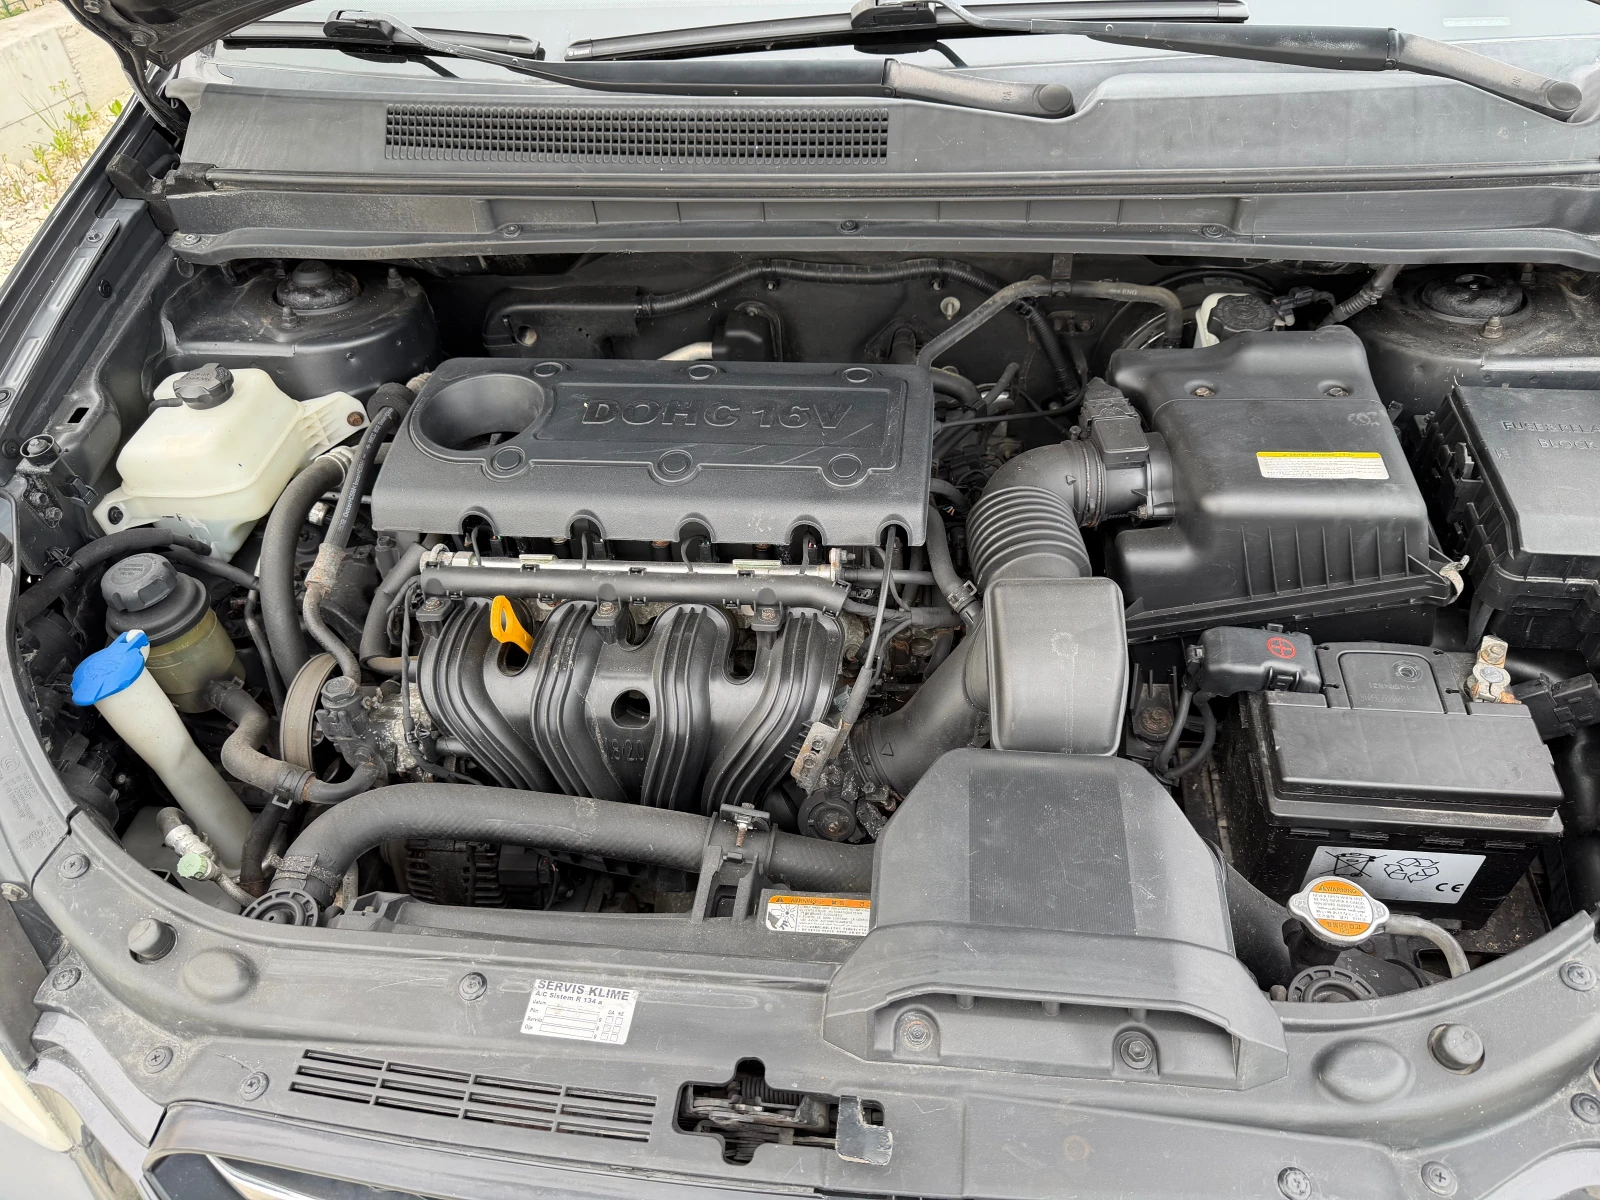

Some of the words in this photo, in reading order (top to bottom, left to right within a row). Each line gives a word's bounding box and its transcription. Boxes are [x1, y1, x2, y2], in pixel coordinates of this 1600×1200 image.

[581, 400, 741, 427] DOHC
[752, 402, 853, 429] 16V
[1537, 439, 1598, 450] BLOCK
[1435, 882, 1465, 893] CE
[537, 980, 585, 995] SERVIS
[588, 986, 630, 1001] KLIME
[549, 992, 574, 1001] Sistem
